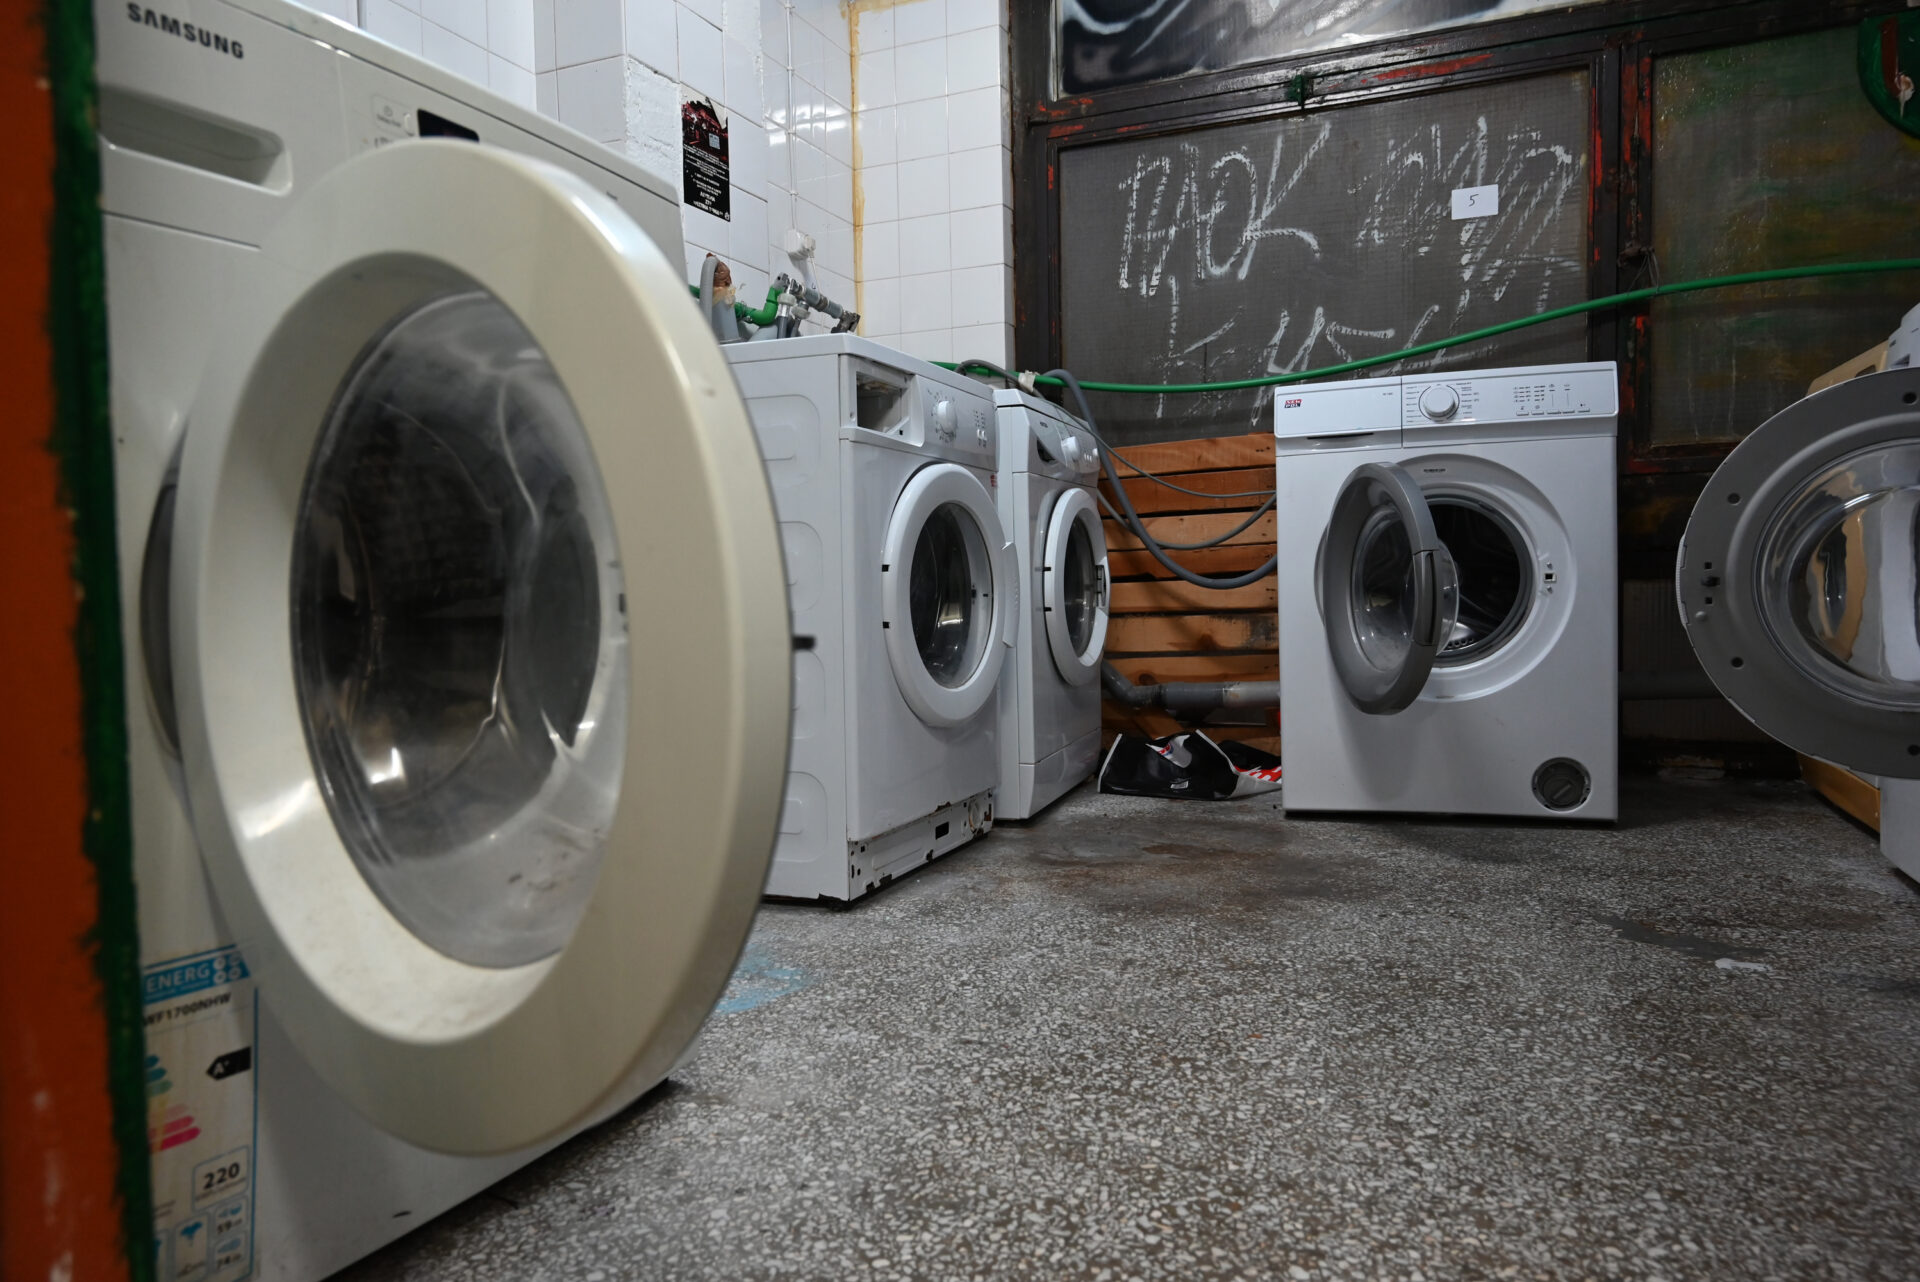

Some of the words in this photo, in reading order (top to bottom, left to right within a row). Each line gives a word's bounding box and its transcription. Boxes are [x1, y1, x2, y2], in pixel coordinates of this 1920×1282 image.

[126, 2, 245, 61] SAMSUNG
[1467, 193, 1480, 207] 5
[145, 962, 211, 993] ENERG
[203, 1162, 241, 1190] 220
